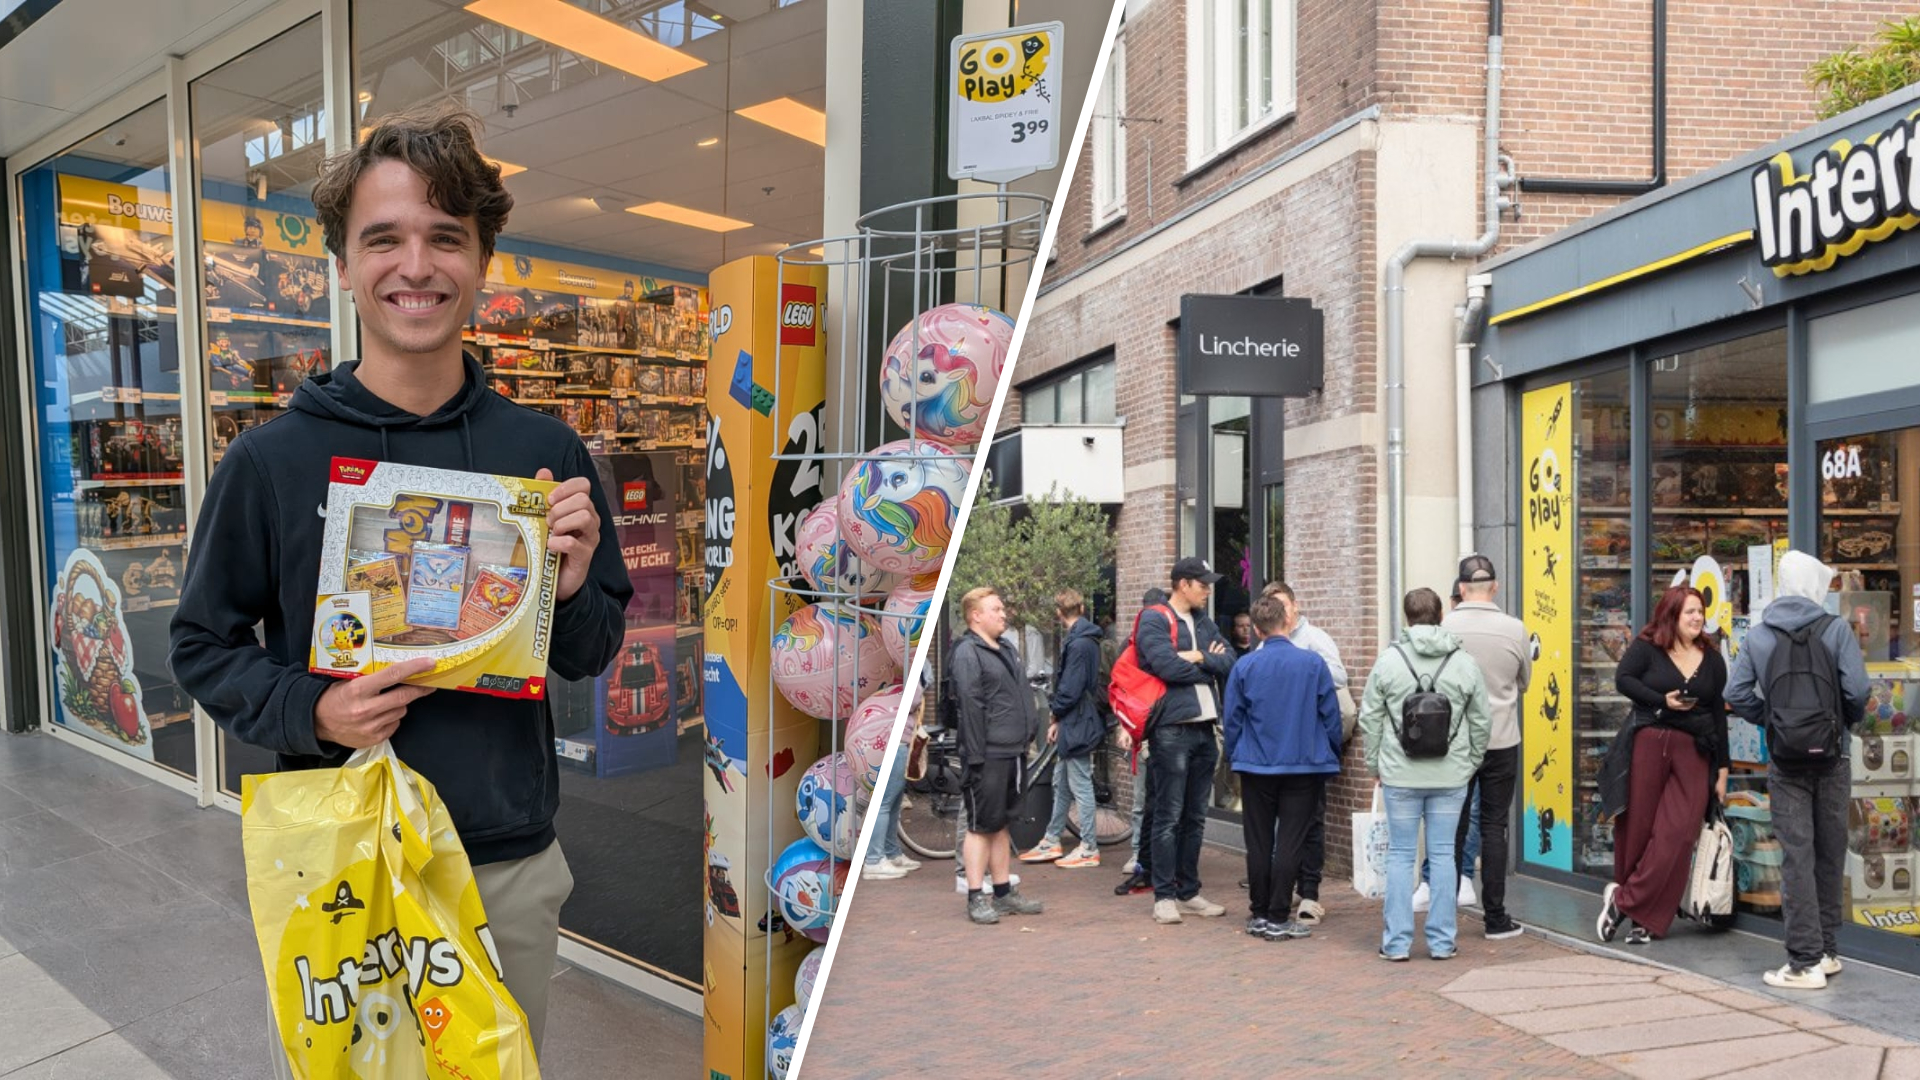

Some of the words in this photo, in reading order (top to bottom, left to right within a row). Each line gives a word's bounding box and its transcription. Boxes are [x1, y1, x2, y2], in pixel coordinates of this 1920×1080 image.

[558, 270, 596, 289] Bouwen
[782, 302, 816, 328] LEGO
[1199, 333, 1301, 357] Lincherie
[1822, 447, 1862, 480] 68A
[625, 490, 646, 501] LEGO
[636, 543, 658, 555] ECHT
[641, 552, 671, 567] ECHT
[713, 616, 738, 632] OP=OP!
[533, 608, 550, 660] POSTER
